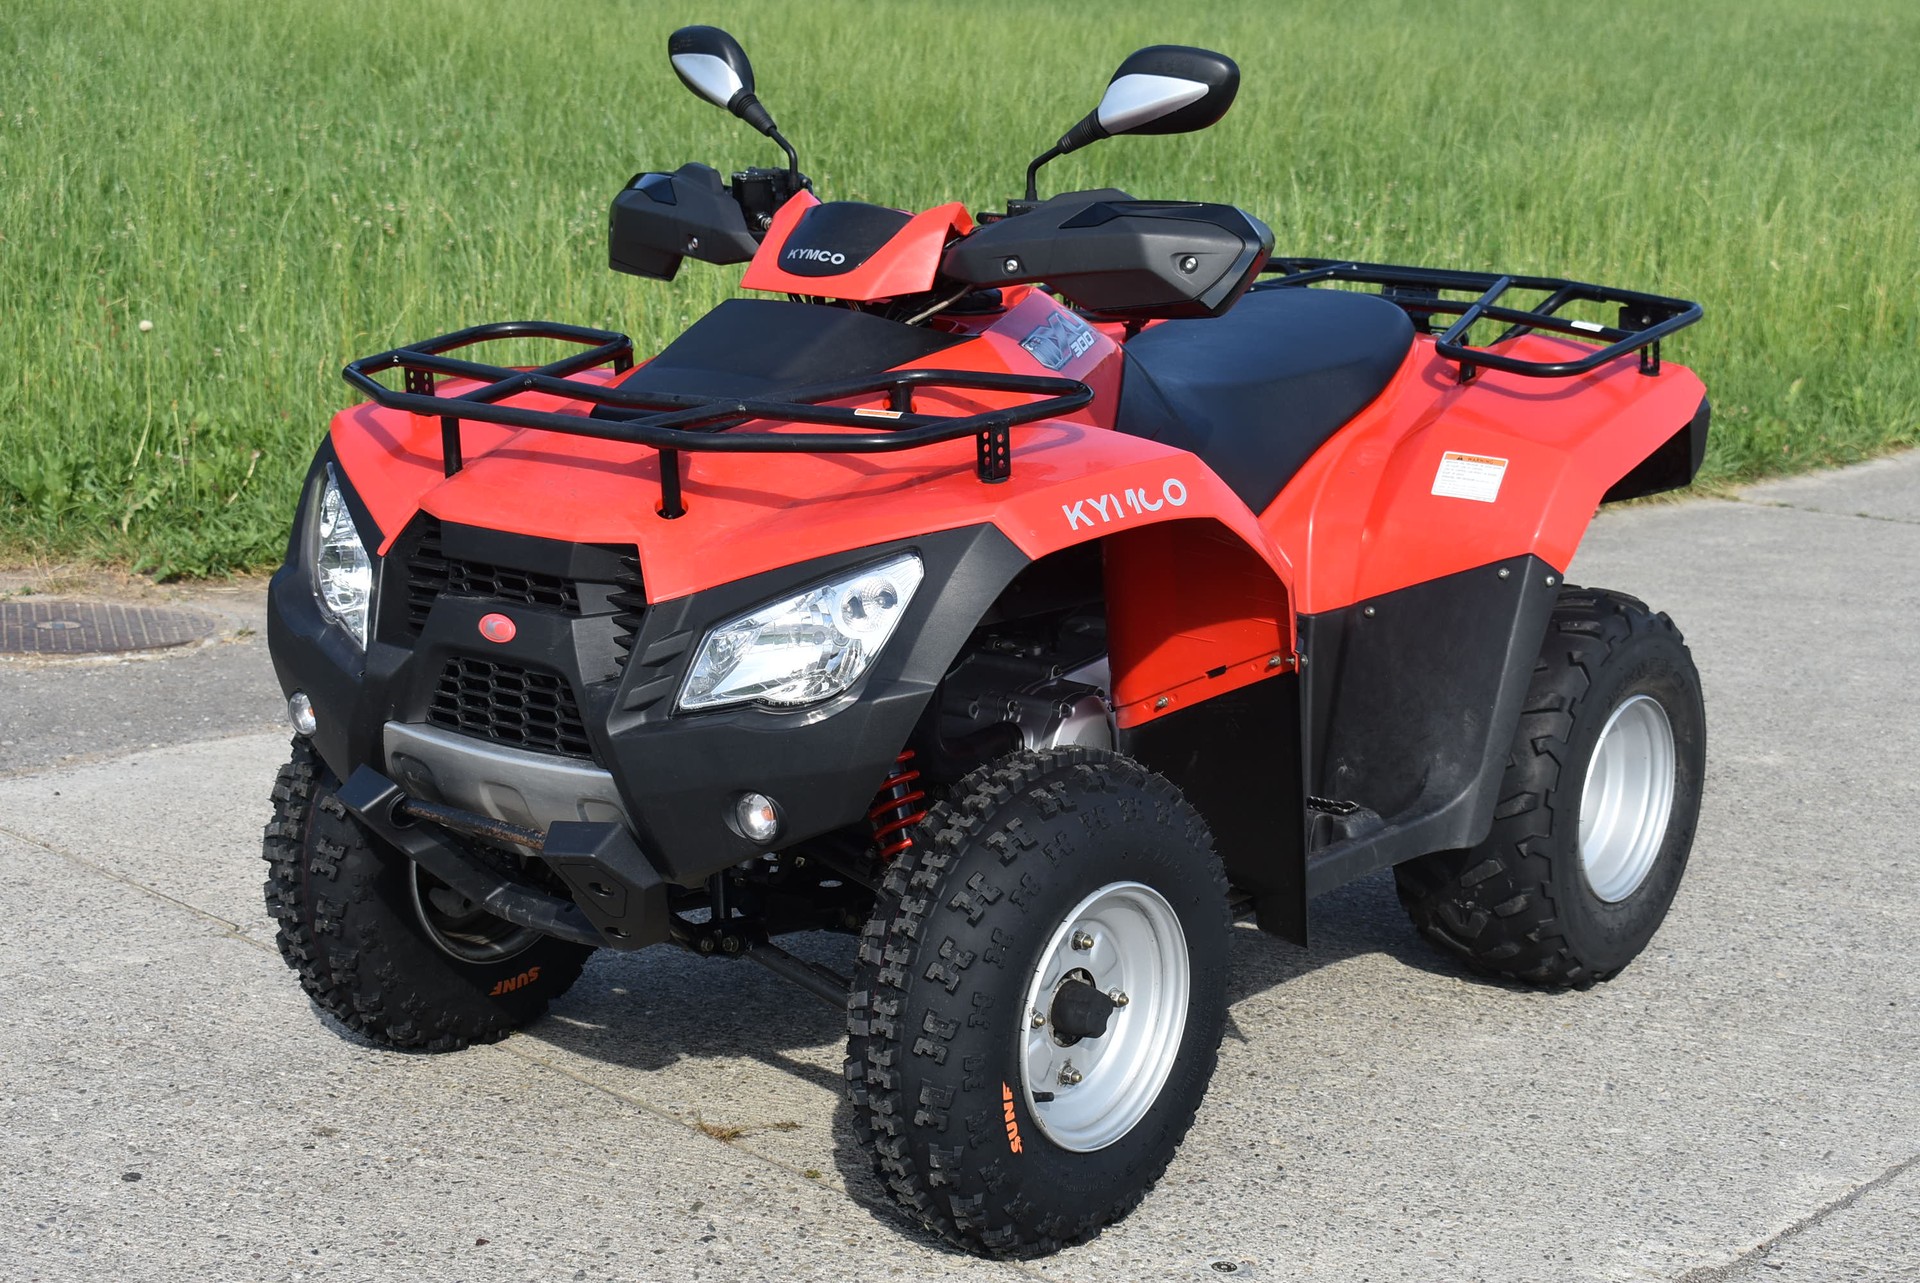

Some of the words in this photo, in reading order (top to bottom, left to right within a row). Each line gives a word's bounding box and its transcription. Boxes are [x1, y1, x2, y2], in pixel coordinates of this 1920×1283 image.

[787, 248, 846, 265] KYMCO
[1070, 331, 1095, 358] 300
[1061, 478, 1188, 531] KYMCO
[488, 965, 542, 996] SUNF
[1002, 1081, 1023, 1154] SUNF
